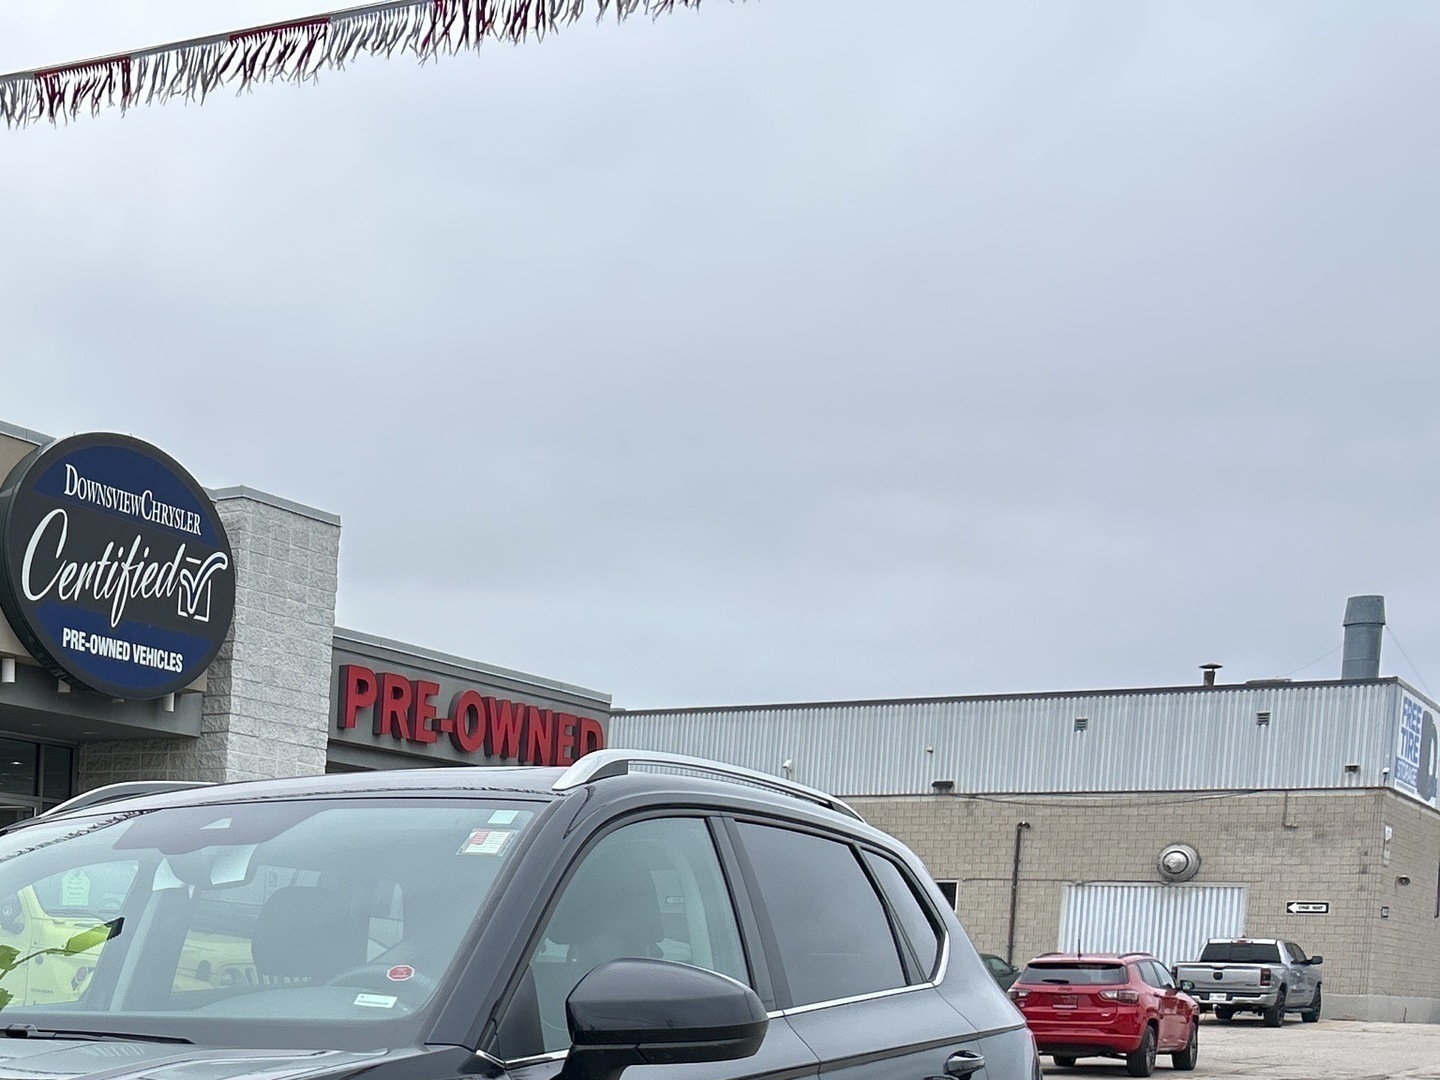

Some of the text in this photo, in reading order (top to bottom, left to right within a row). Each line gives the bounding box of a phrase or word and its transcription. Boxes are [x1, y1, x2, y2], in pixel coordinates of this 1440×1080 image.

[21, 508, 186, 628] Certified
[62, 627, 183, 673] PRE-OWNED VEHICLES
[339, 664, 604, 766] PRE-OWNED
[1402, 696, 1422, 735] FREE
[1401, 726, 1421, 765] TIRE
